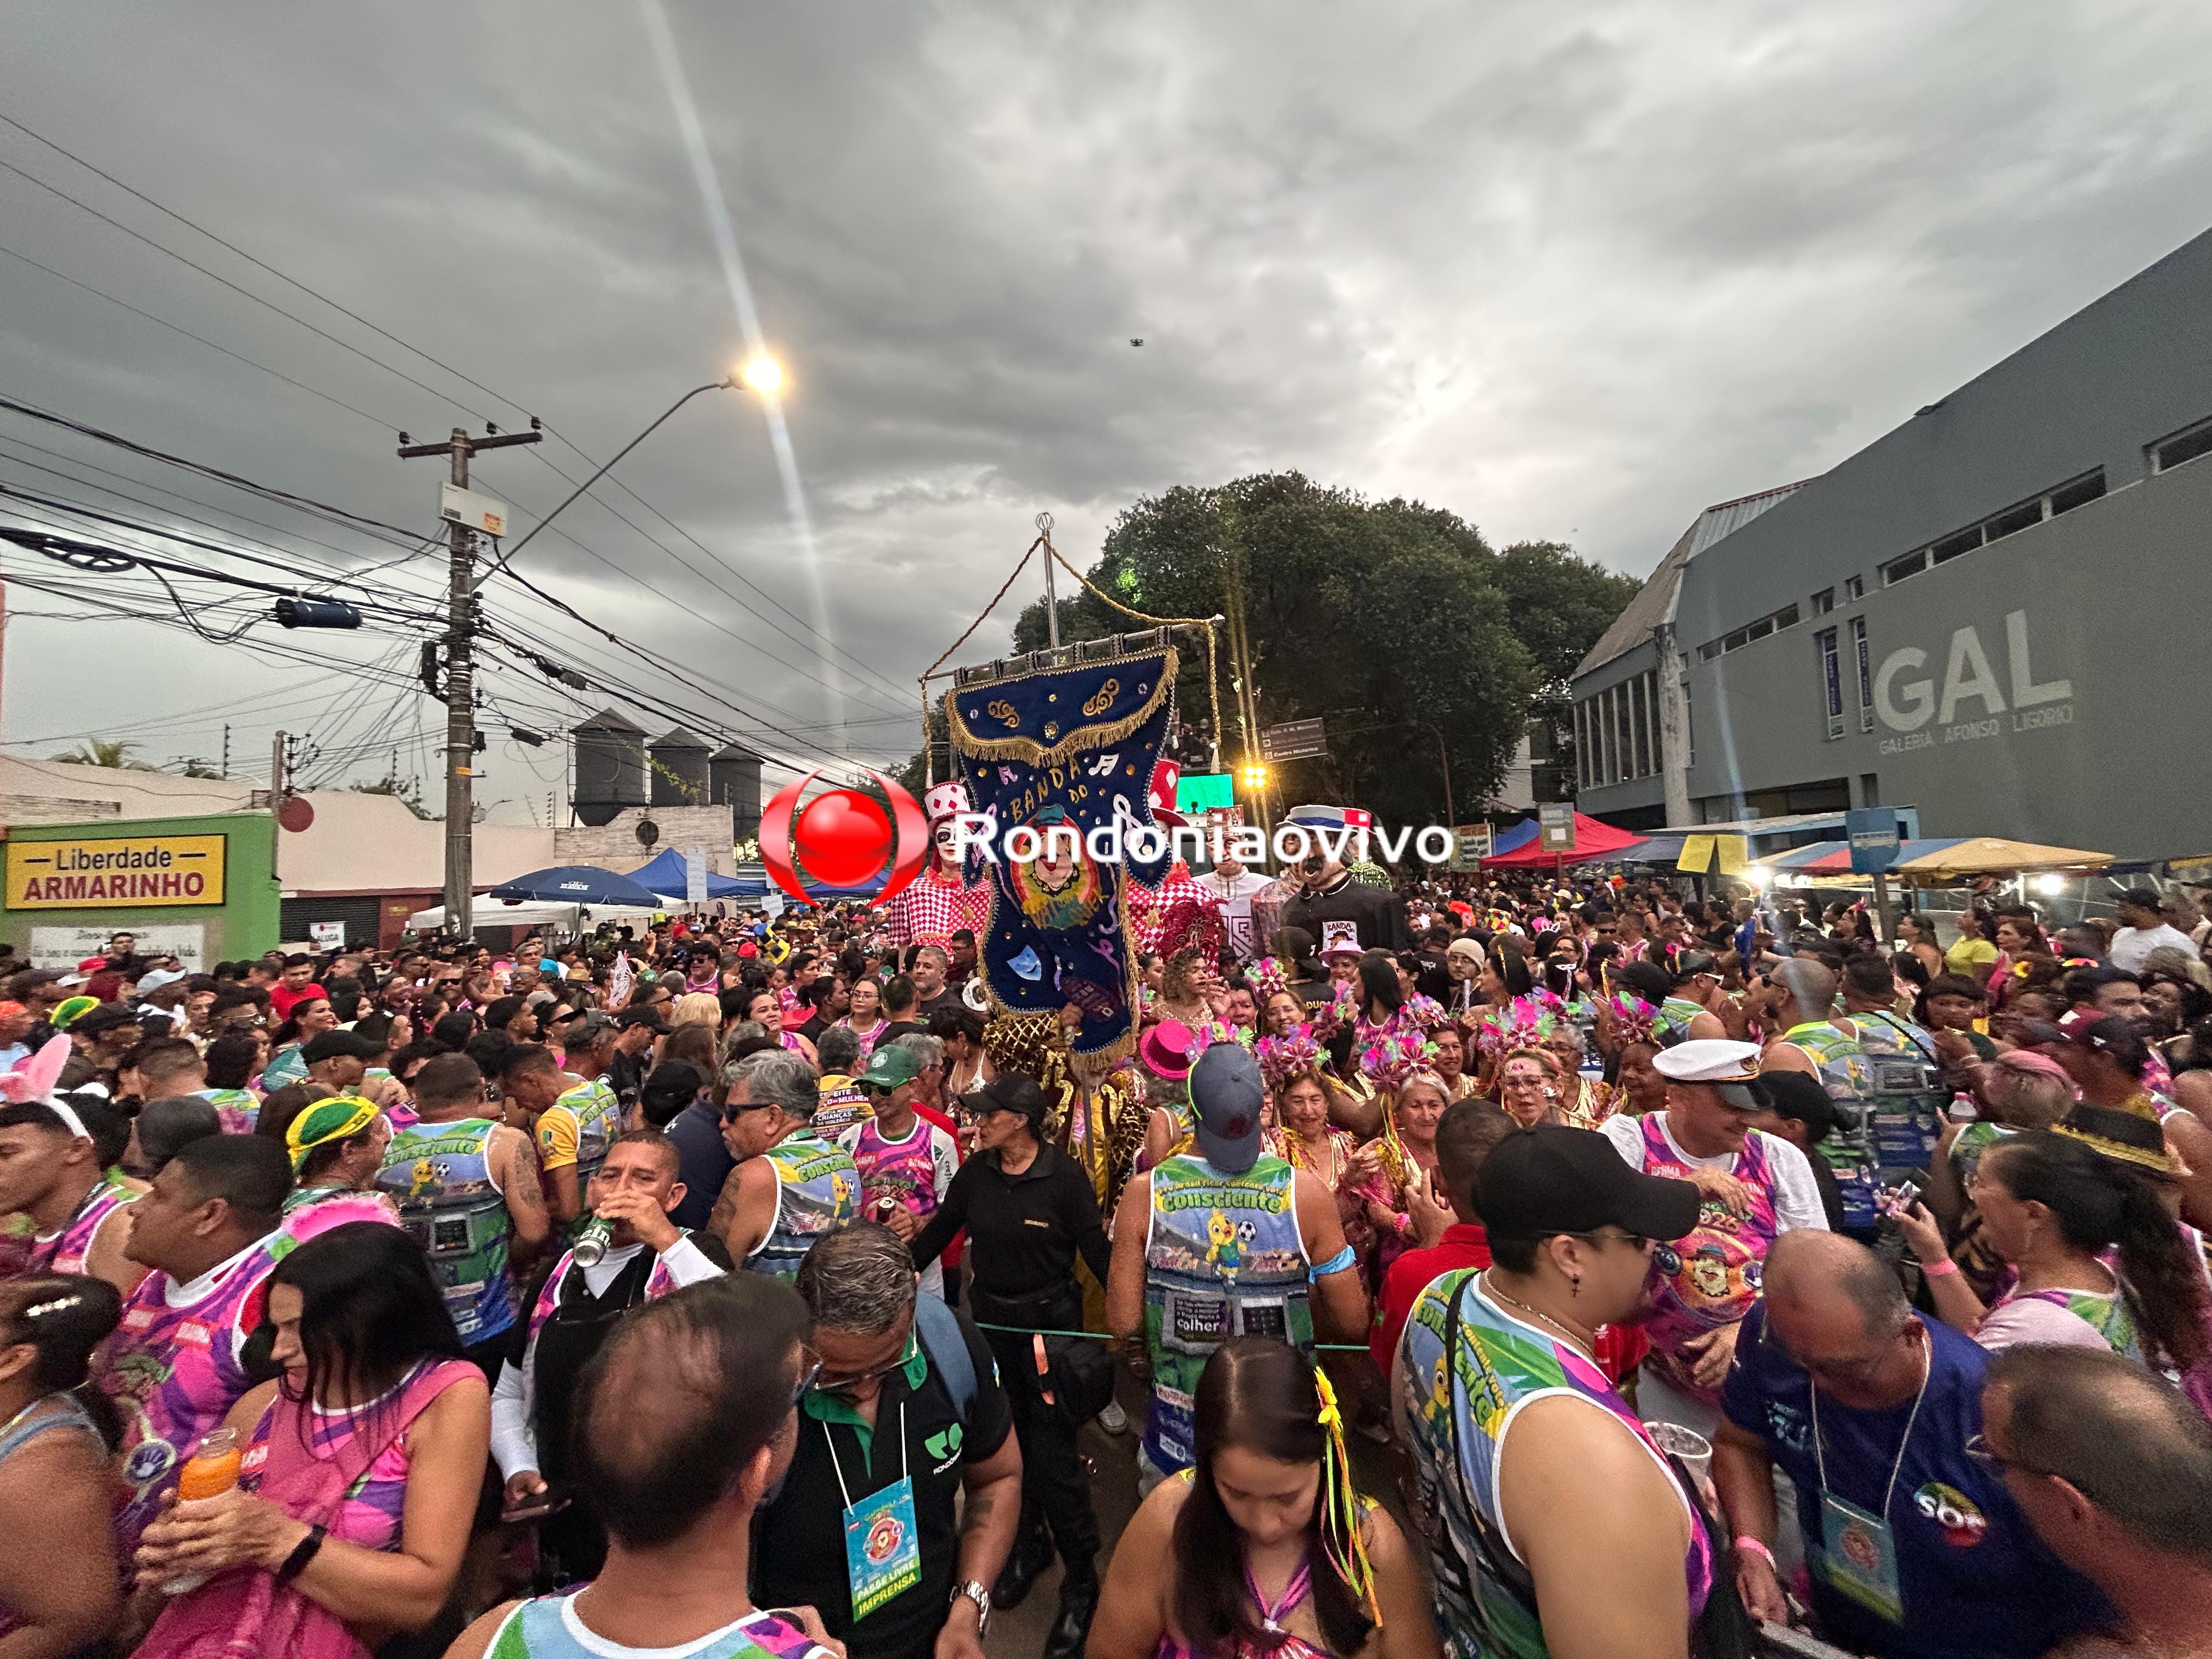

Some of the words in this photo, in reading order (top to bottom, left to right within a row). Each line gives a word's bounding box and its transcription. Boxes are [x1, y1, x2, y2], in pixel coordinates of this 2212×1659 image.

[1873, 609, 2073, 732] GAL
[1880, 731, 1935, 755] GALERIA
[1944, 719, 2001, 743] AFONSO
[1009, 755, 1081, 823] BANDA
[1069, 783, 1088, 804] DO
[57, 845, 172, 871] Liberdade
[24, 871, 205, 901] ARMARINHO
[317, 934, 339, 943] ALUGA
[838, 1095, 869, 1103] MULHER
[817, 1111, 852, 1121] CRIANÇAS
[1162, 1188, 1282, 1214] consciente
[1177, 1318, 1220, 1331] colher
[857, 1573, 888, 1600] PASSE
[888, 1559, 916, 1581] LIVRE
[858, 1572, 916, 1616] IMPRENSA
